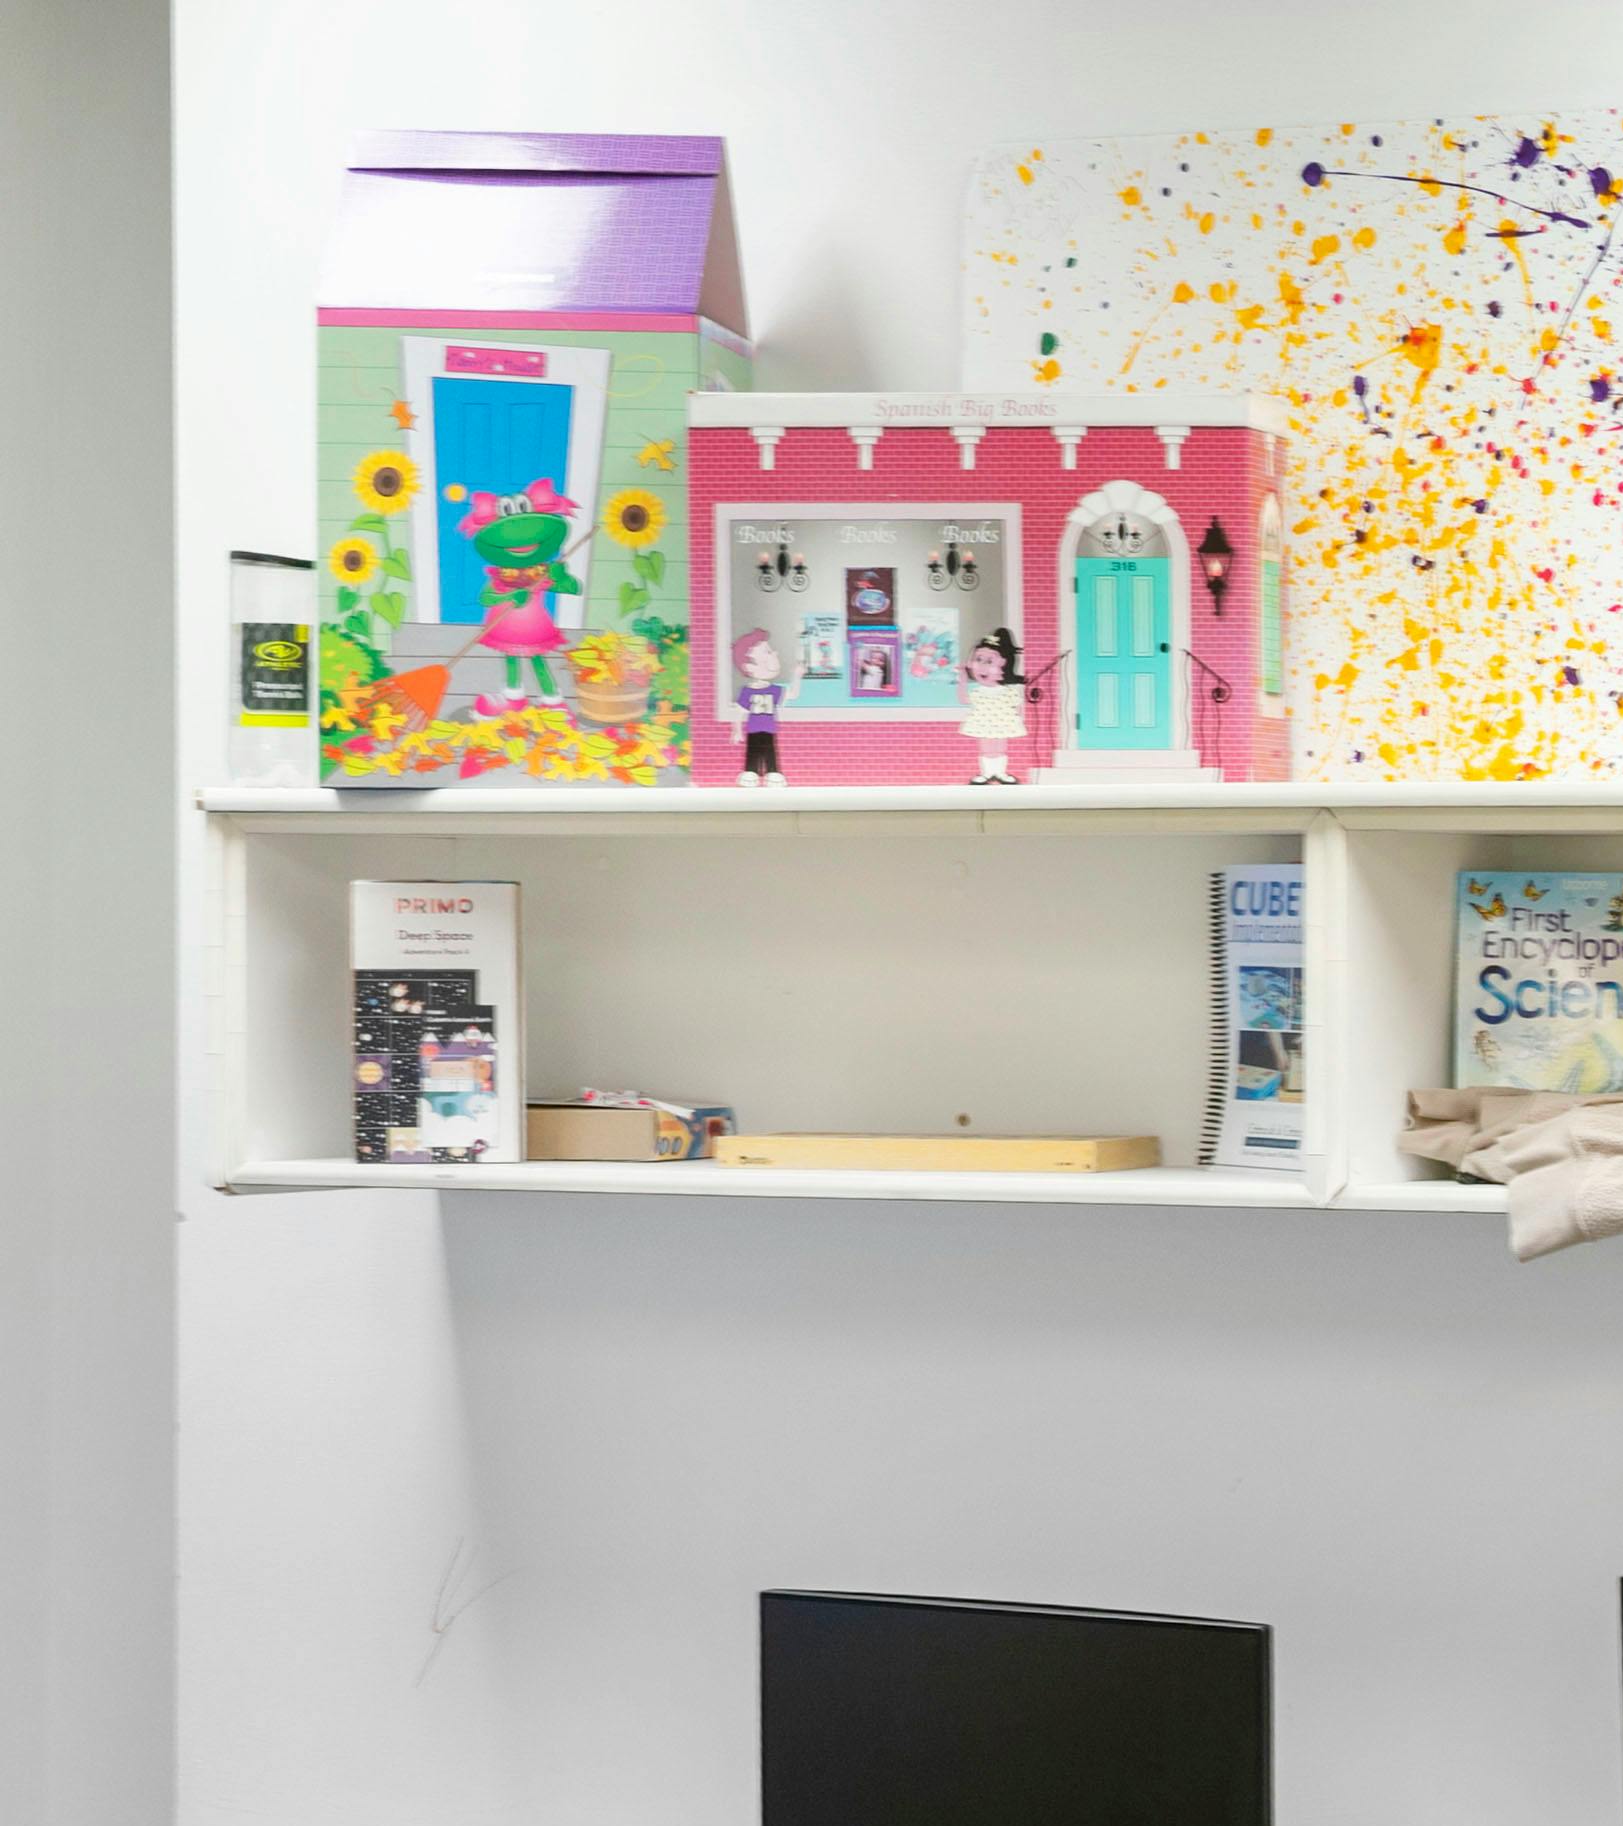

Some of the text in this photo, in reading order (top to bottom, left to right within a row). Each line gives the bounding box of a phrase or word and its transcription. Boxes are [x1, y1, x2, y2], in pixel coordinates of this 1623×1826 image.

[875, 396, 1057, 422] Spanish Big Books
[735, 524, 794, 543] Books
[841, 524, 897, 543] Books
[939, 523, 999, 543] Books
[394, 897, 474, 914] PRIMO
[1511, 906, 1573, 933] First
[397, 929, 473, 943] Deep Space
[1578, 962, 1596, 978] of
